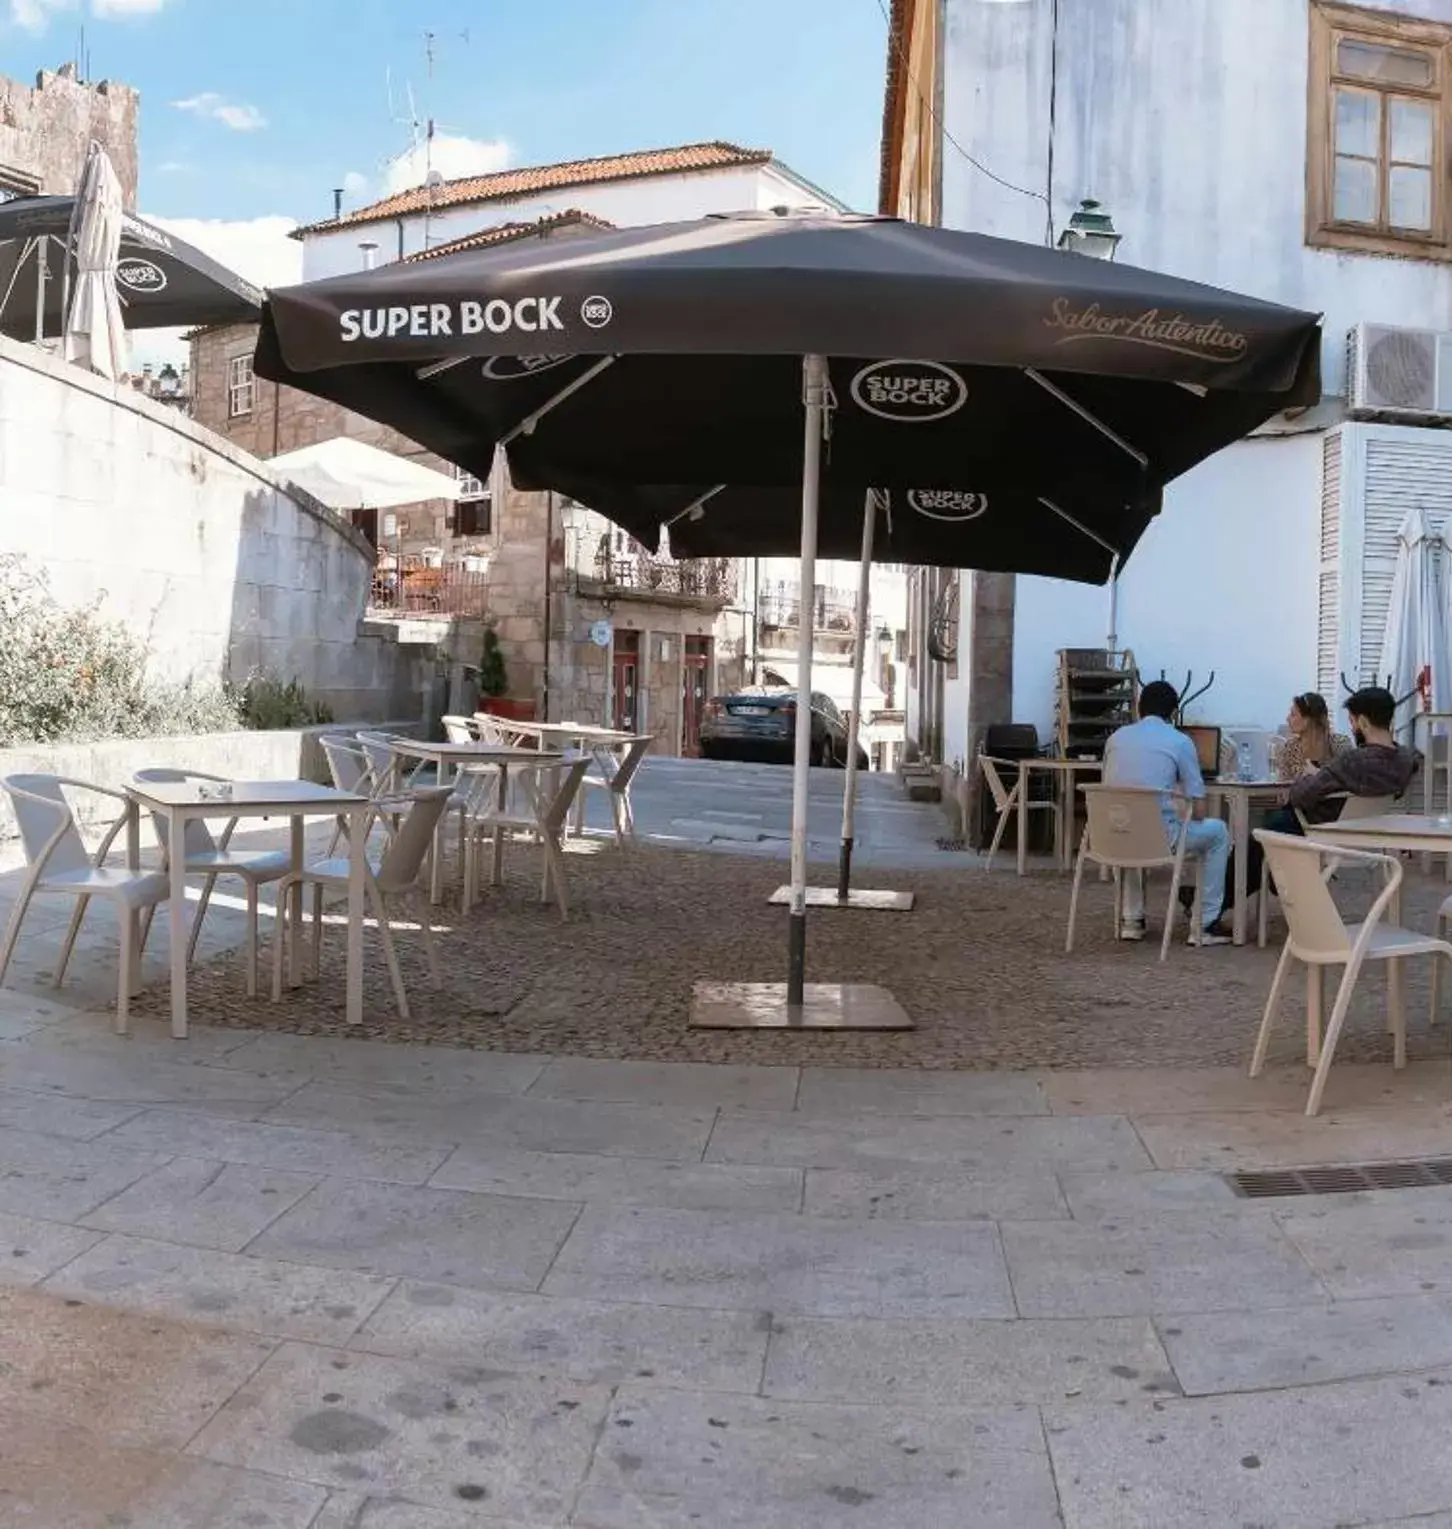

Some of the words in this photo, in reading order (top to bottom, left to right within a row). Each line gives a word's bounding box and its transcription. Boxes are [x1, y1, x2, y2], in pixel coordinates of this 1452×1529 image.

[340, 303, 453, 342] SUPER
[460, 296, 564, 335] BOCK
[1043, 296, 1128, 333] Sabor
[867, 376, 950, 393] SUPER
[869, 390, 946, 405] BOCK
[918, 491, 975, 502] SUPER
[921, 499, 973, 510] BOCK
